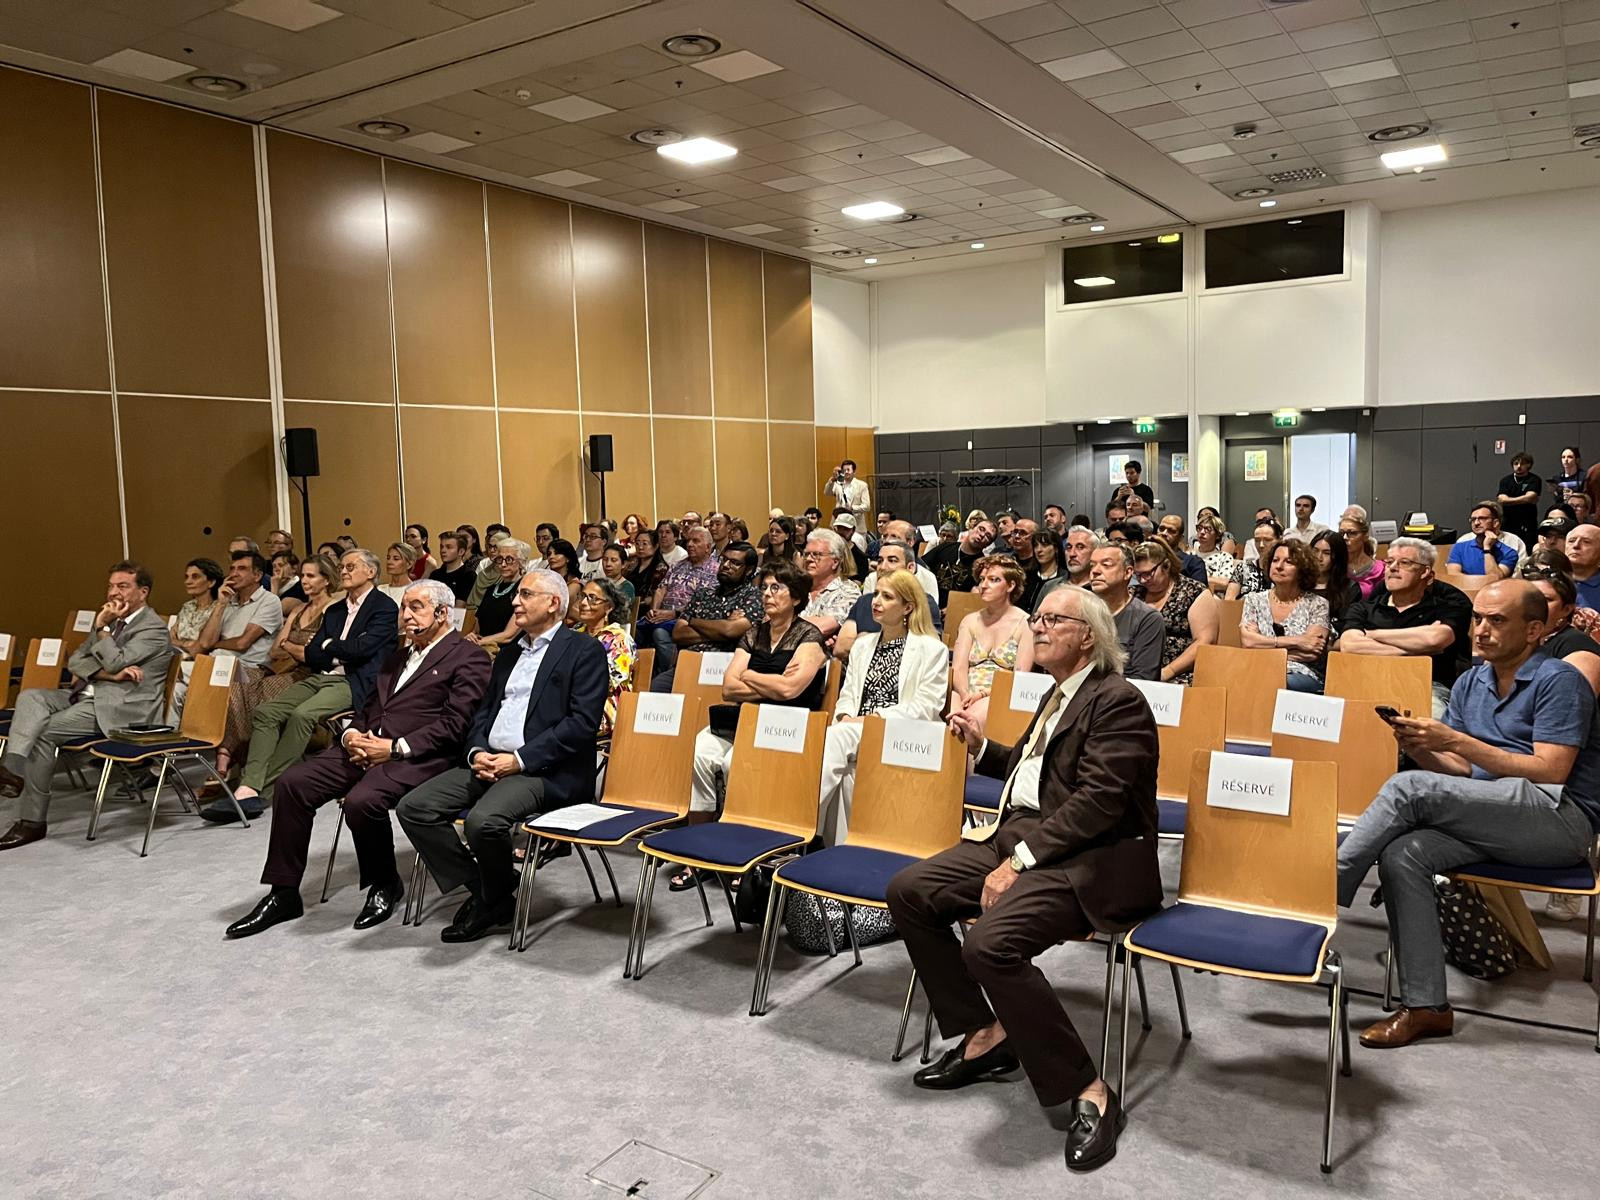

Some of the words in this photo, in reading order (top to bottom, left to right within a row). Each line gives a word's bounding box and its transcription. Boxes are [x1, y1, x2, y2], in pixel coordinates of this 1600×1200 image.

[643, 711, 673, 723] RÉSERVÉ
[1284, 711, 1329, 728] RÉSERVÉ
[764, 725, 797, 738] RÉSERVÉ
[893, 740, 932, 756] RÉSERVÉ
[1221, 778, 1276, 796] RÉSERVÉ
